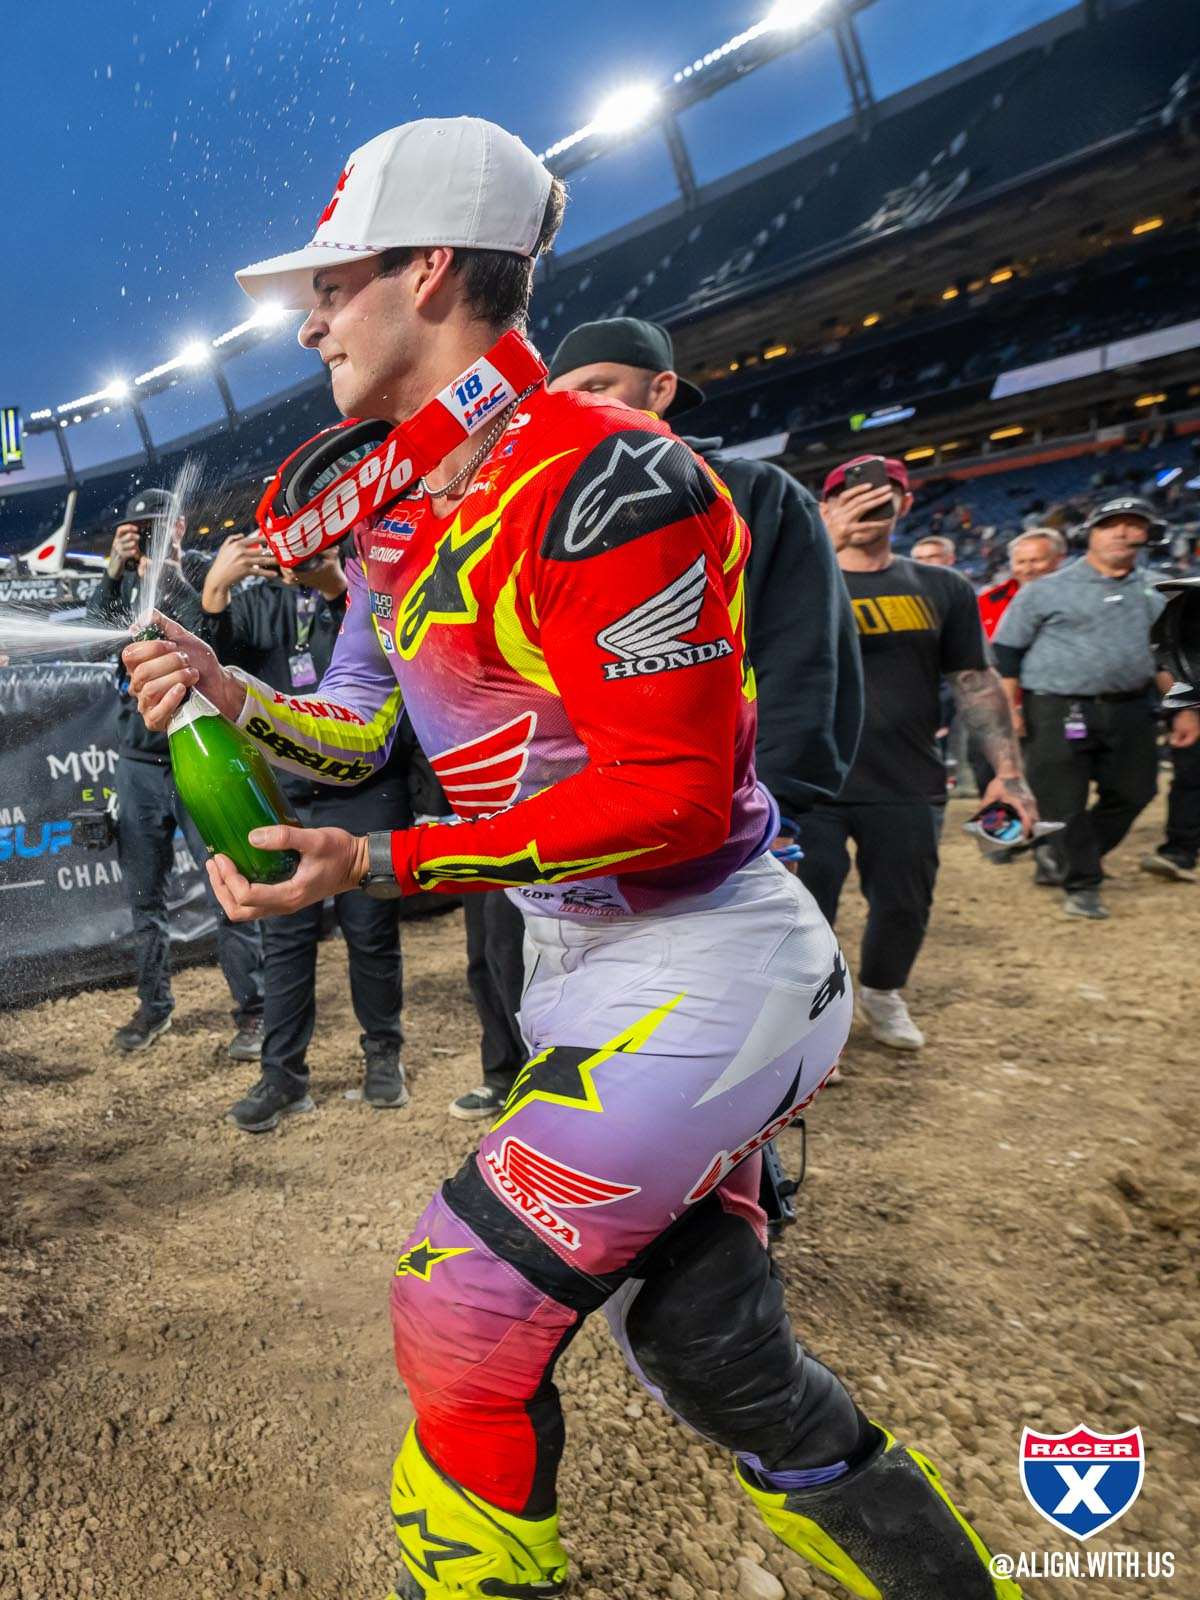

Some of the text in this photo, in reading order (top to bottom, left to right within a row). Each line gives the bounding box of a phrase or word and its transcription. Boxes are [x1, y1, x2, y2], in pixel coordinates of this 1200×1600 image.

[456, 374, 483, 407] 18
[463, 382, 506, 427] HRC
[270, 439, 413, 562] 100%
[604, 639, 734, 680] HONDA
[487, 1157, 575, 1246] HONDA
